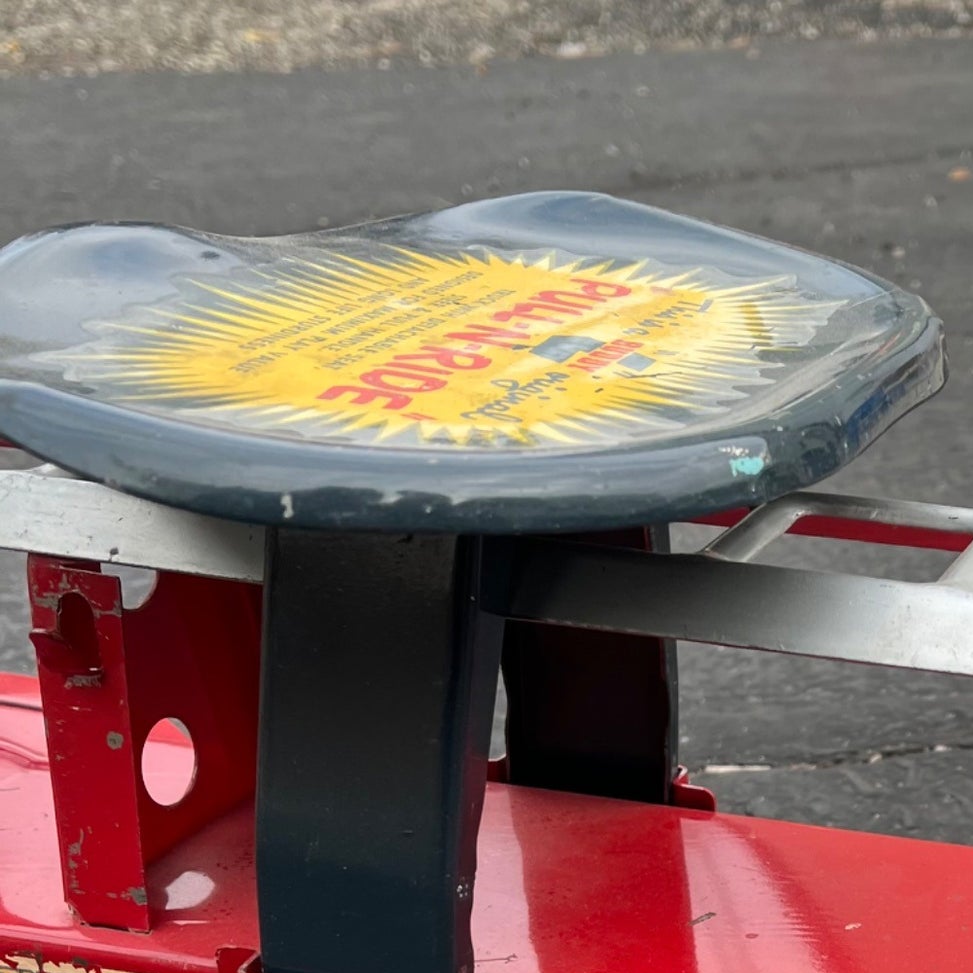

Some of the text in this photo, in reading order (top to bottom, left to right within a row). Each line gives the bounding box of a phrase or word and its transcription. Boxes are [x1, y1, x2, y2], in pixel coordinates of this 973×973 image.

[421, 270, 484, 295] DESIGNED
[320, 305, 398, 335] MAXIMUM
[653, 299, 715, 320] This
[356, 317, 447, 354] DETACHABLE
[621, 327, 650, 336] a
[227, 351, 289, 373] VALUE
[566, 339, 645, 373] BUDDY
[459, 371, 572, 424] original
